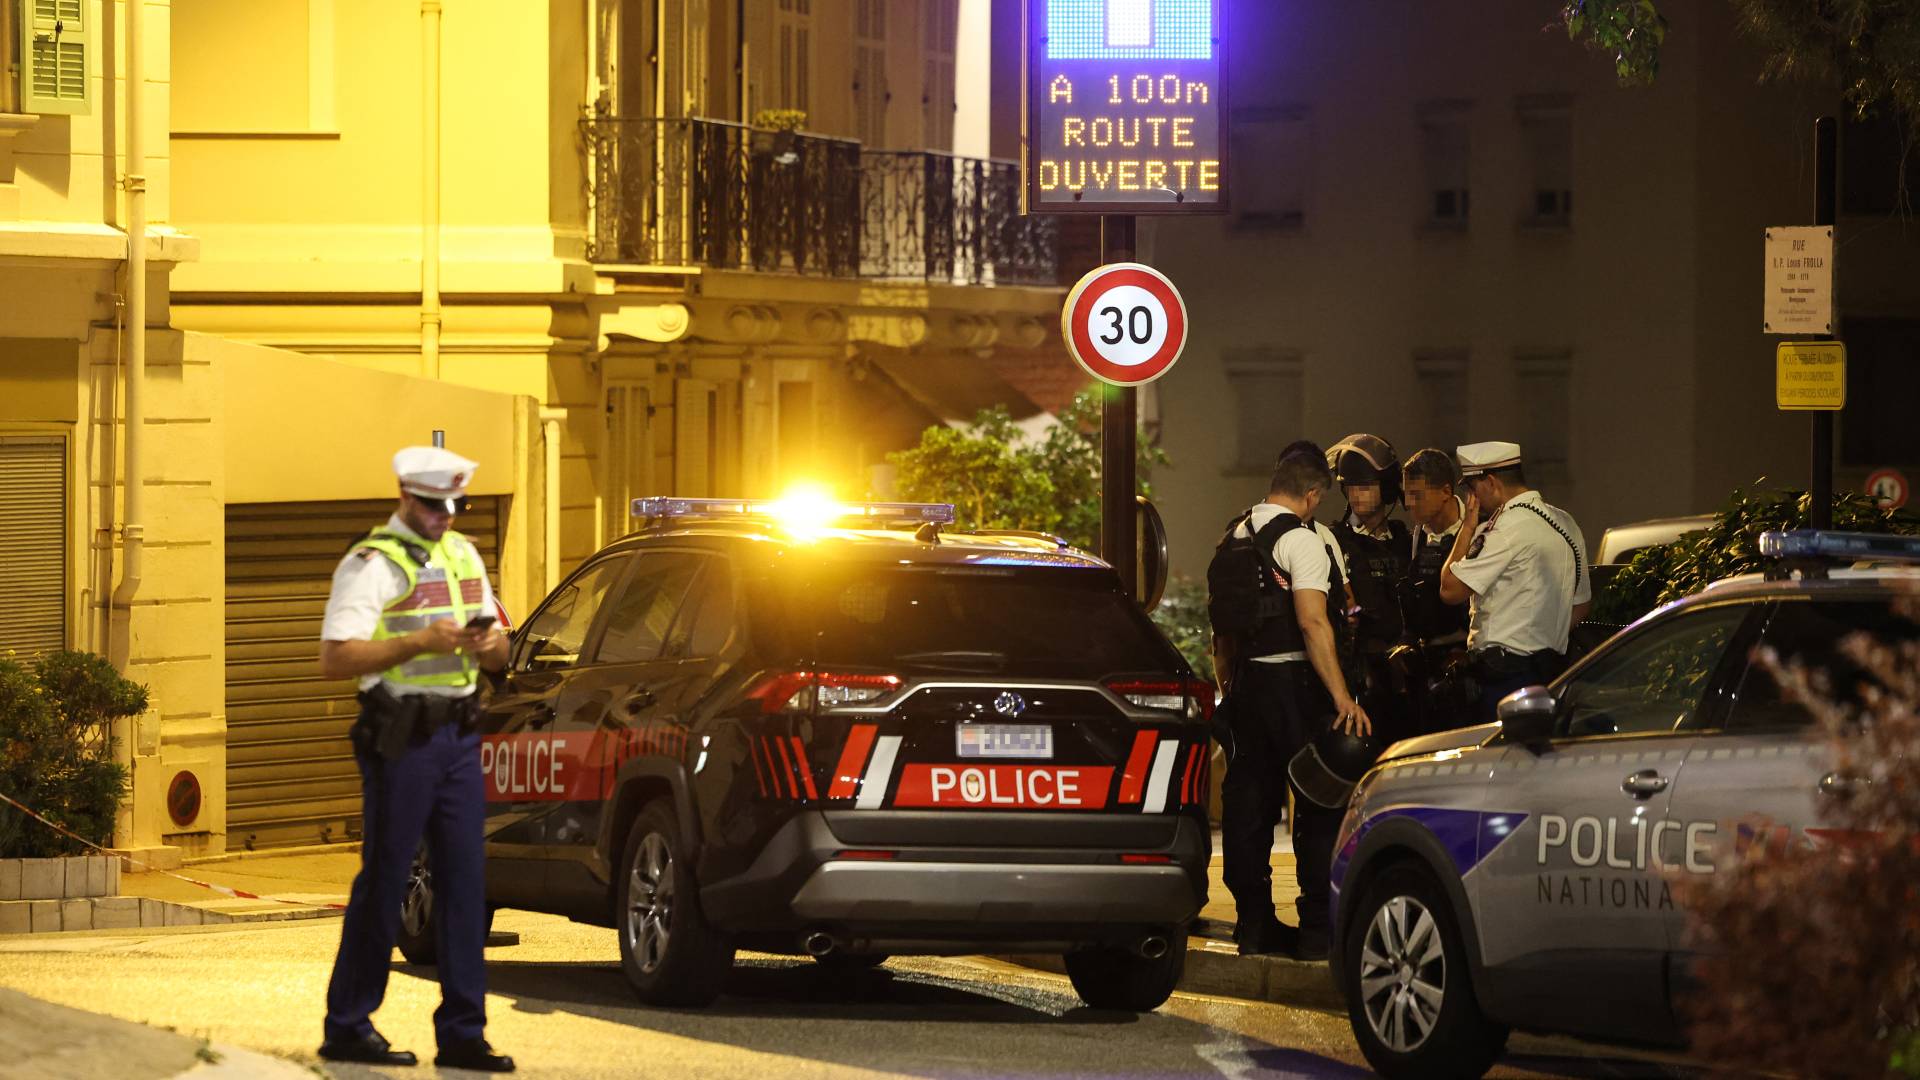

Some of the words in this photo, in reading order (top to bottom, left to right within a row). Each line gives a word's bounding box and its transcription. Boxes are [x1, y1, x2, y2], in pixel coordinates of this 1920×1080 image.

[1051, 75, 1072, 103] A
[1108, 75, 1209, 103] 100m
[1064, 118, 1194, 147] ROUTE
[1040, 161, 1219, 190] OUVERTE
[1792, 239, 1806, 252] RUE
[1099, 306, 1152, 345] 30
[481, 739, 566, 793] POLICE
[931, 767, 1082, 805] POLICE
[1537, 814, 1718, 874] POLICE
[1537, 875, 1676, 911] NATIONA
